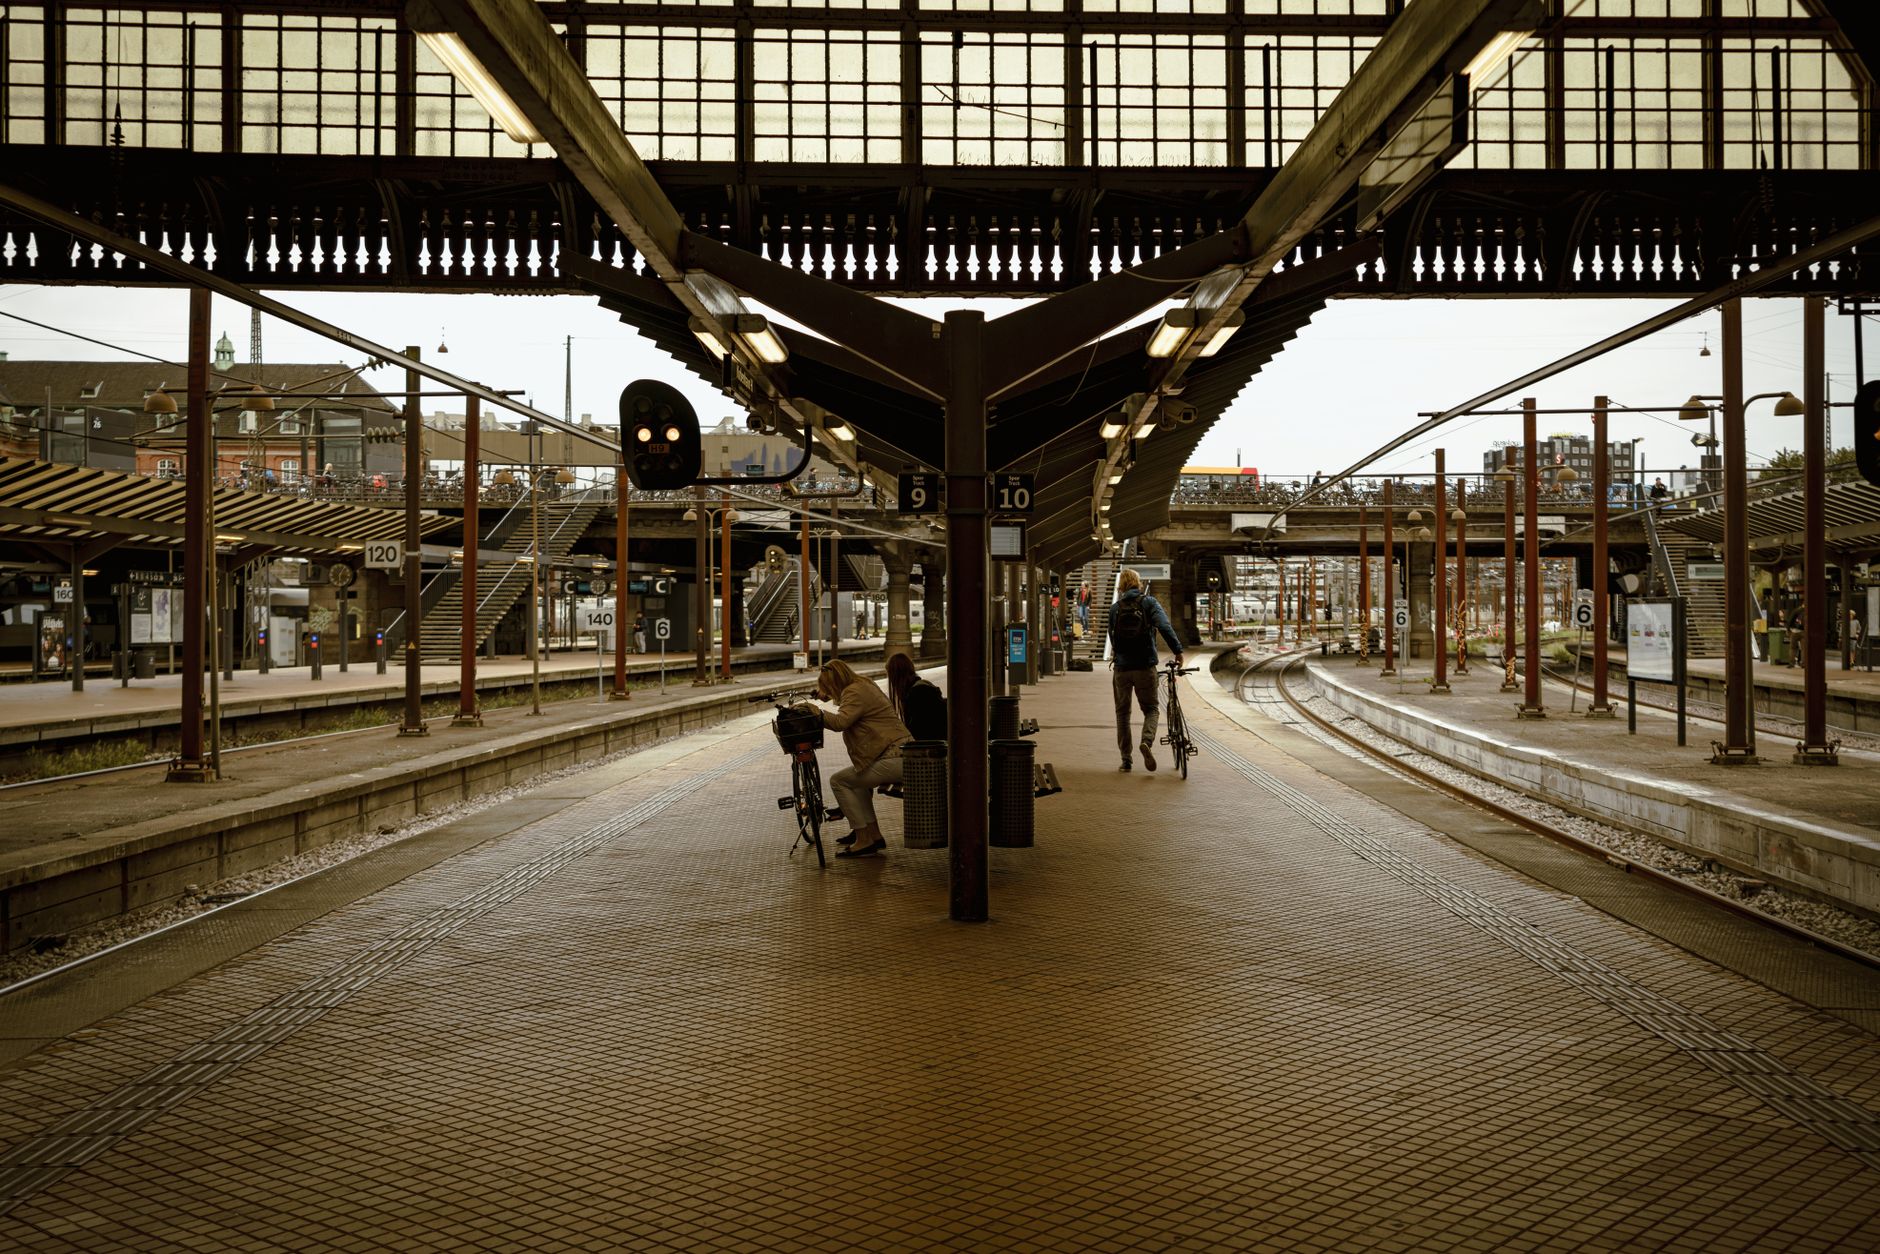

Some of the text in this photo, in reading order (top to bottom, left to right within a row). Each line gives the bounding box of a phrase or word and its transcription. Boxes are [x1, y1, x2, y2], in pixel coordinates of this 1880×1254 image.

[911, 487, 926, 509] 9
[1000, 487, 1030, 509] 10
[368, 546, 397, 562] 120
[564, 581, 574, 594] C
[655, 580, 666, 593] C
[587, 613, 613, 626] 140
[1396, 611, 1406, 625] 6
[1577, 604, 1592, 623] 6
[657, 621, 669, 637] 6
